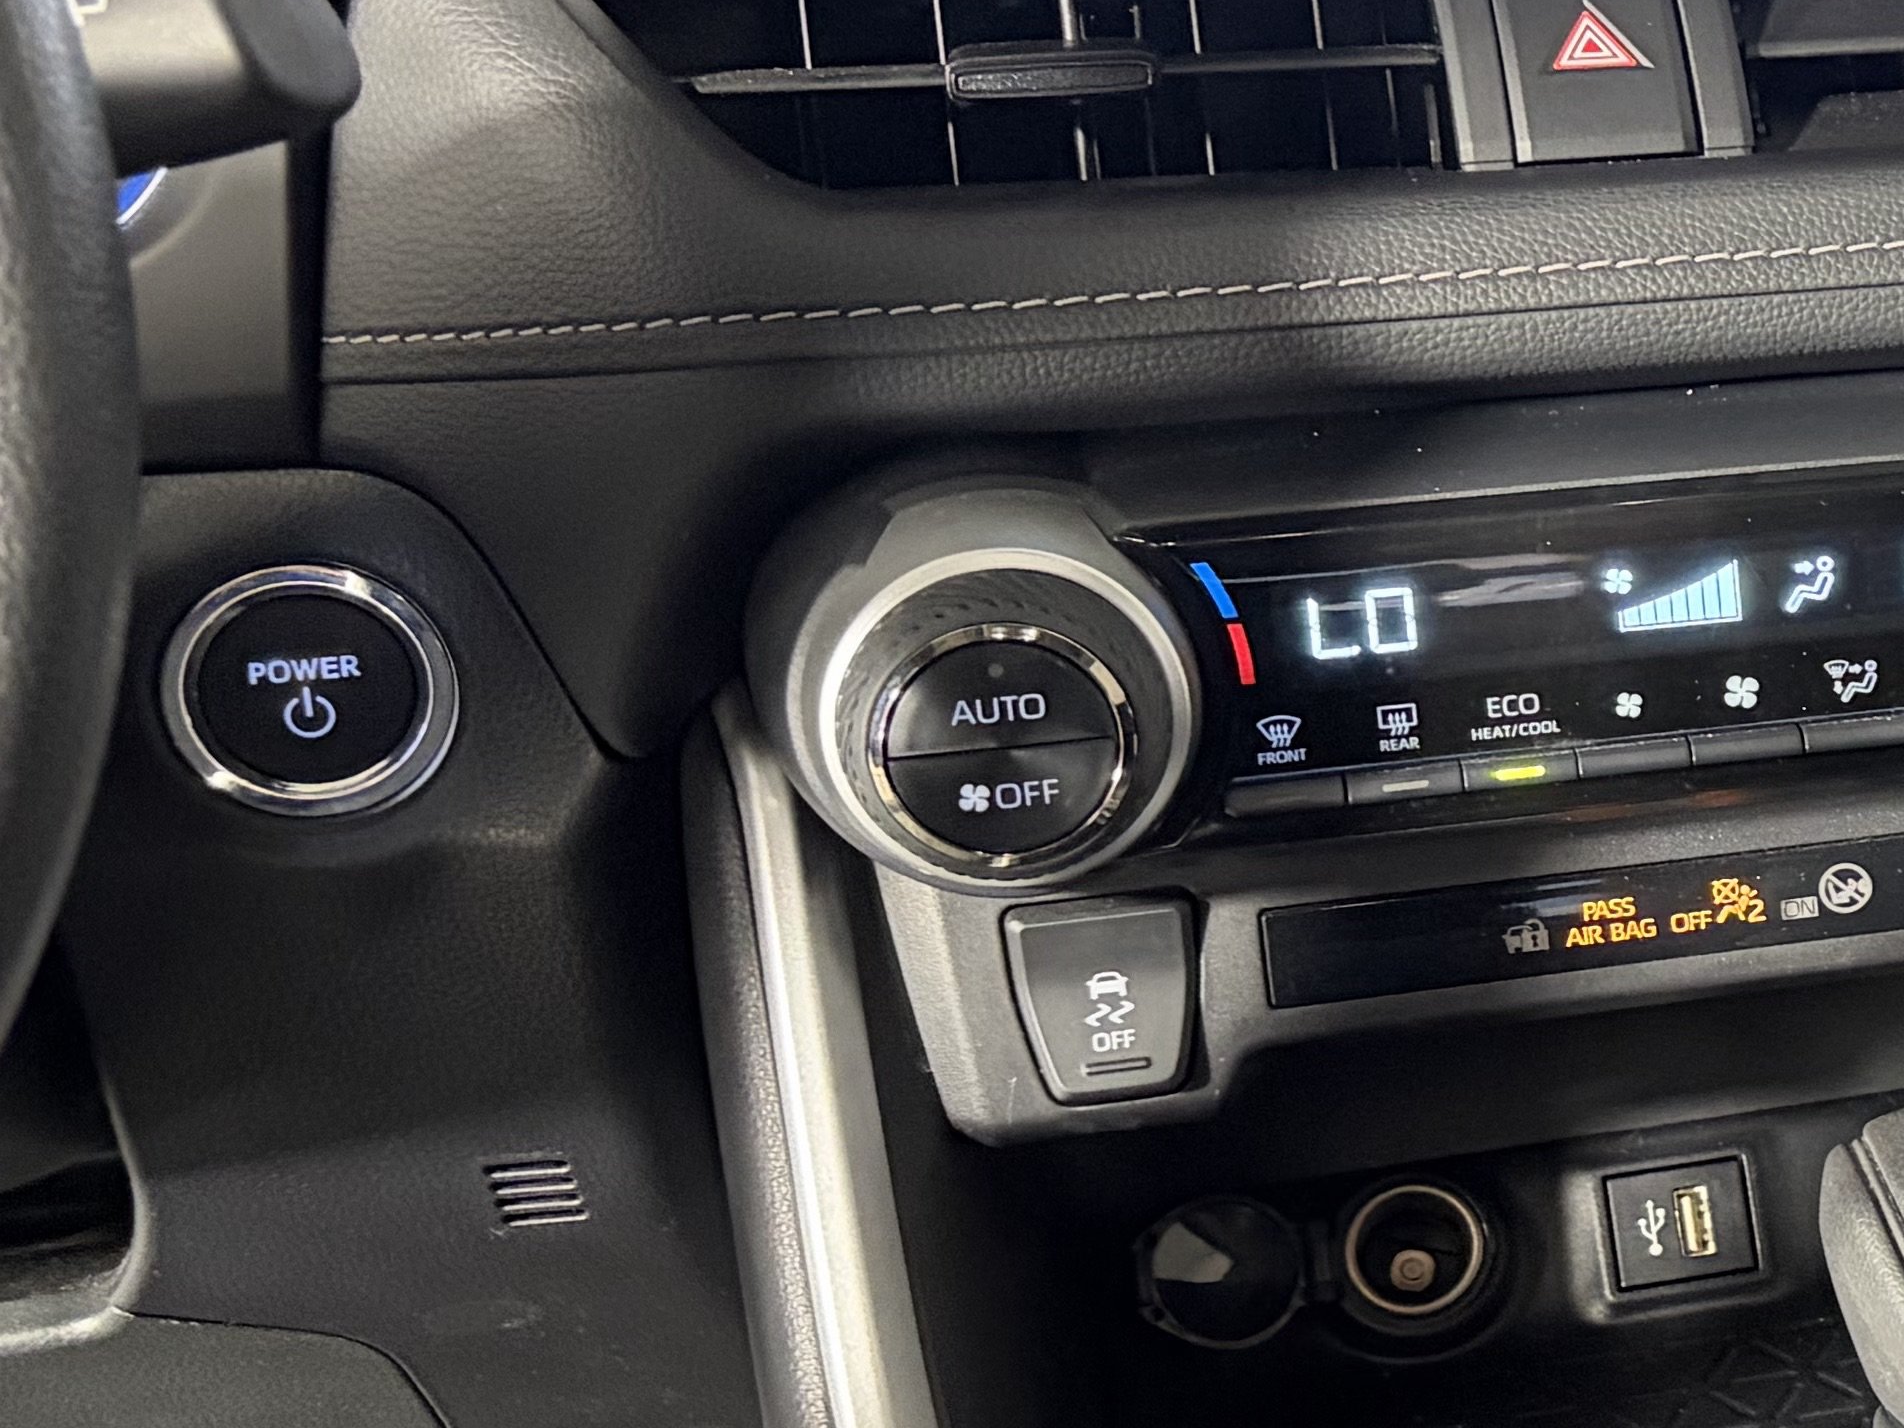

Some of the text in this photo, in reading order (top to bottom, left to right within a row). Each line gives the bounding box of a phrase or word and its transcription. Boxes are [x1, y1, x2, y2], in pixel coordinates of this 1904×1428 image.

[1306, 587, 1418, 660] LO
[247, 654, 361, 685] POWER
[951, 693, 1046, 726] AUTO
[1486, 693, 1540, 718] ECO
[1470, 720, 1561, 742] HEAT/COOL
[1257, 748, 1307, 766] FRONT
[1379, 737, 1420, 752] REAR
[995, 779, 1059, 809] OFF
[1582, 897, 1636, 921] PASS
[1784, 900, 1816, 917] ON
[1565, 925, 1605, 947] AIR
[1610, 918, 1657, 943] BAG
[1670, 909, 1713, 933] OFF
[1092, 1027, 1136, 1053] OFF
